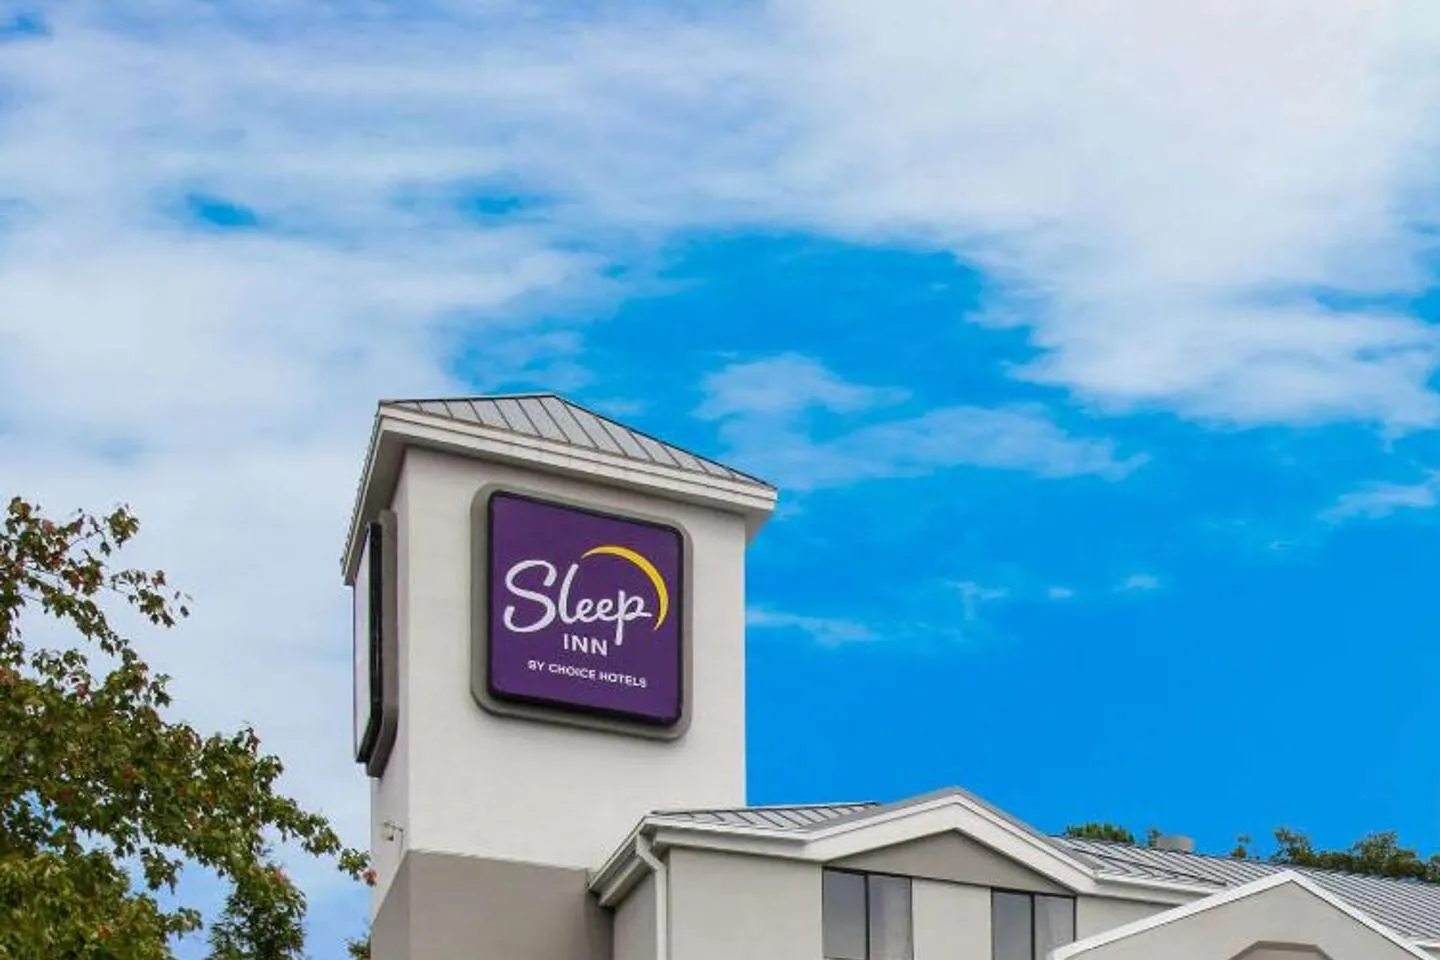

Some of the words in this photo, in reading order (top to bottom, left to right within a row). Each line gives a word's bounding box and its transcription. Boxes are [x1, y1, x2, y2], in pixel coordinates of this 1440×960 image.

[504, 560, 652, 646] Sleep
[563, 633, 607, 656] INN
[528, 660, 545, 671] BY
[548, 663, 596, 680] CHOICE
[599, 671, 647, 688] HOTELS
